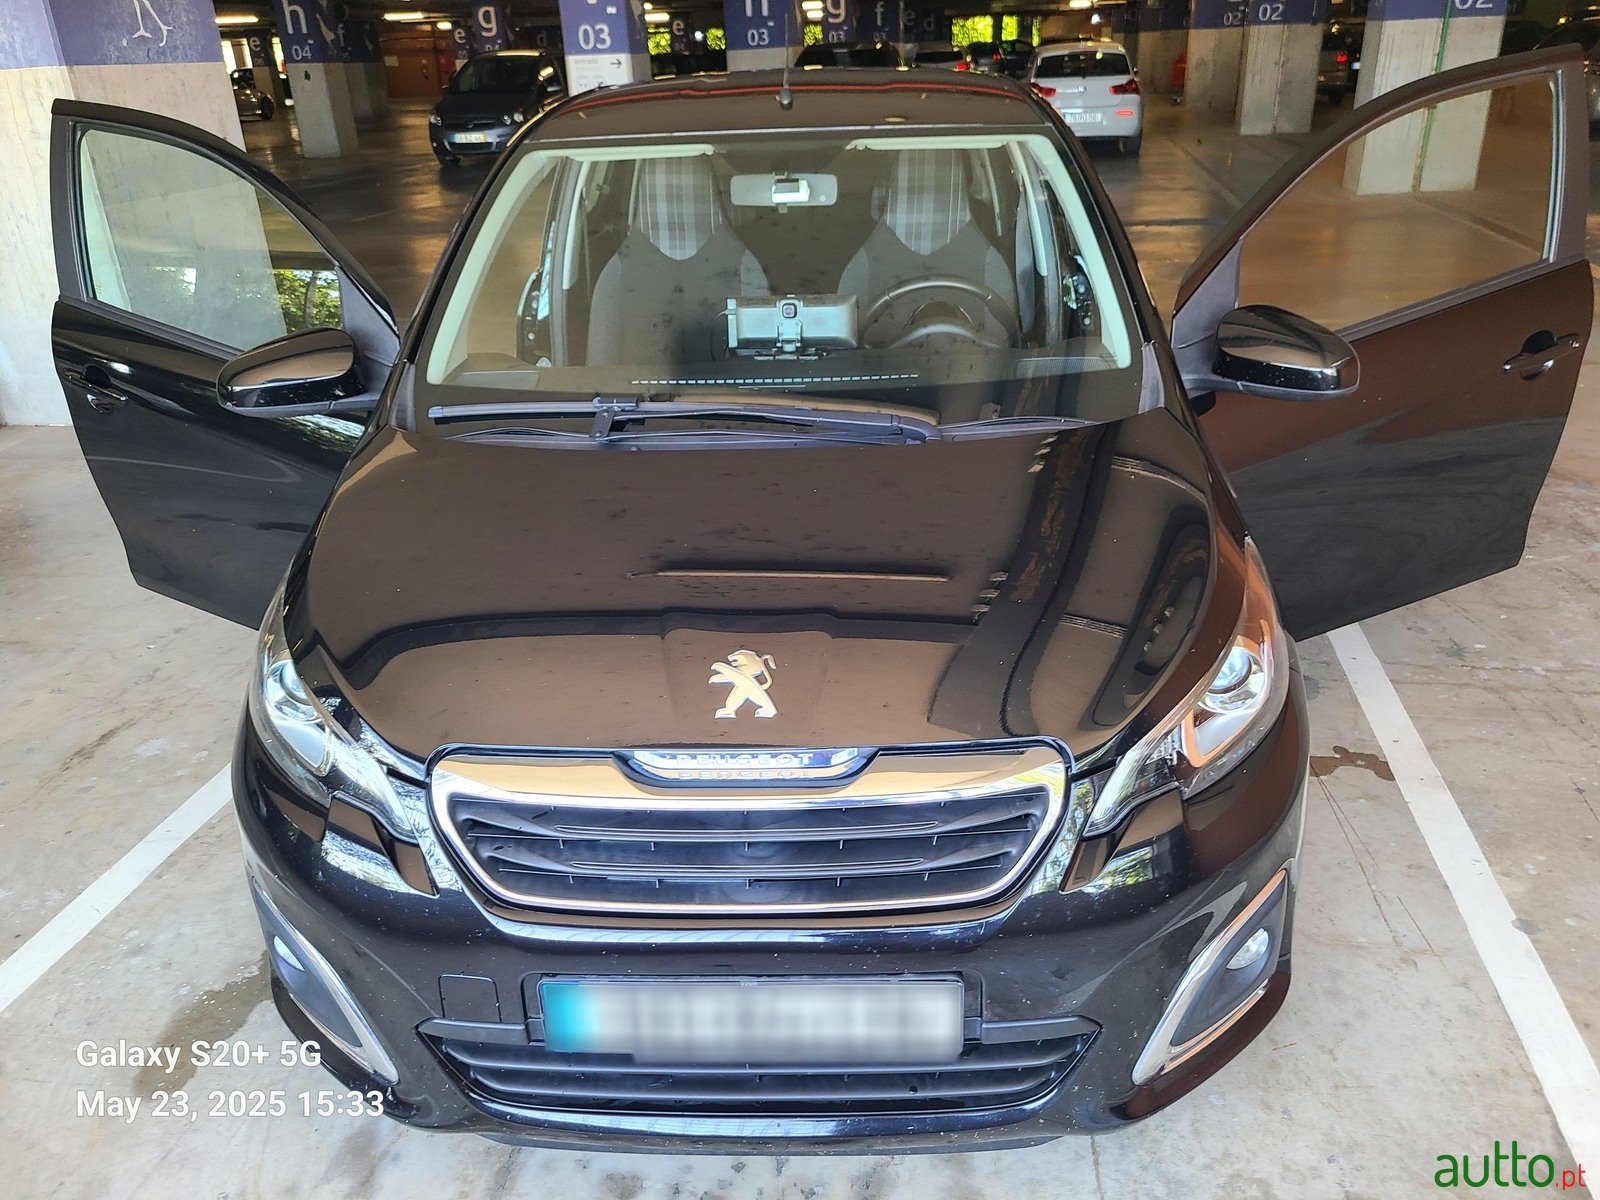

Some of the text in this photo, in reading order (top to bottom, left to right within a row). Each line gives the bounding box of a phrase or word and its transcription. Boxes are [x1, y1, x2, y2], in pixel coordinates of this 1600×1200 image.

[1223, 12, 1242, 26] 02
[1258, 3, 1285, 22] 02
[477, 6, 498, 37] g
[672, 19, 685, 36] e
[249, 36, 261, 52] e
[453, 28, 466, 44] e
[577, 22, 612, 51] 03
[747, 28, 770, 47] 03
[291, 44, 312, 61] 04
[676, 753, 814, 767] PEUGEOT
